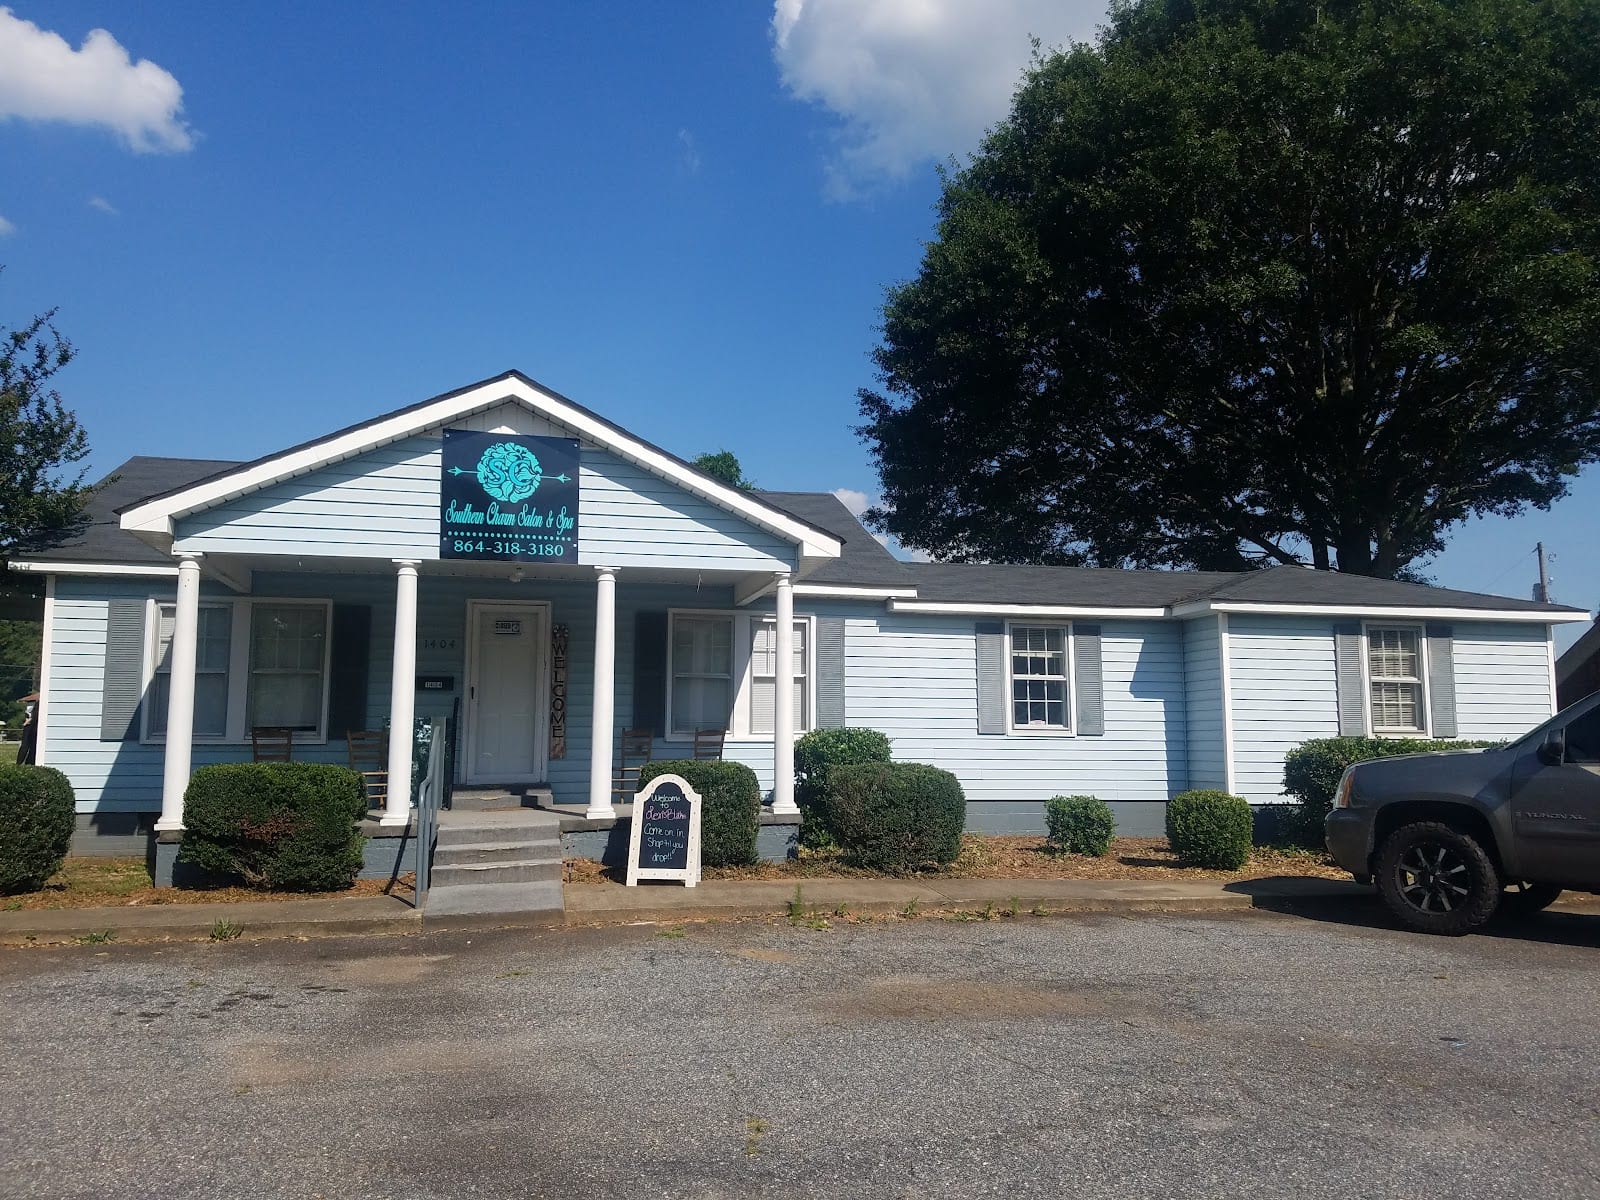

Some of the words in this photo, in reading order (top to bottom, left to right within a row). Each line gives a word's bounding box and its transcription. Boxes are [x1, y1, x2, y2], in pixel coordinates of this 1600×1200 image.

[445, 499, 485, 525] Southern
[486, 501, 517, 526] Charm
[517, 503, 543, 528] Salon
[545, 510, 554, 528] &
[556, 506, 575, 535] Spa
[453, 540, 564, 556] 864-318-3180
[424, 639, 456, 649] 1404
[552, 642, 566, 738] WELCOME
[651, 794, 681, 802] Welcome
[644, 823, 663, 835] Come
[677, 829, 684, 837] in
[672, 842, 683, 854] you
